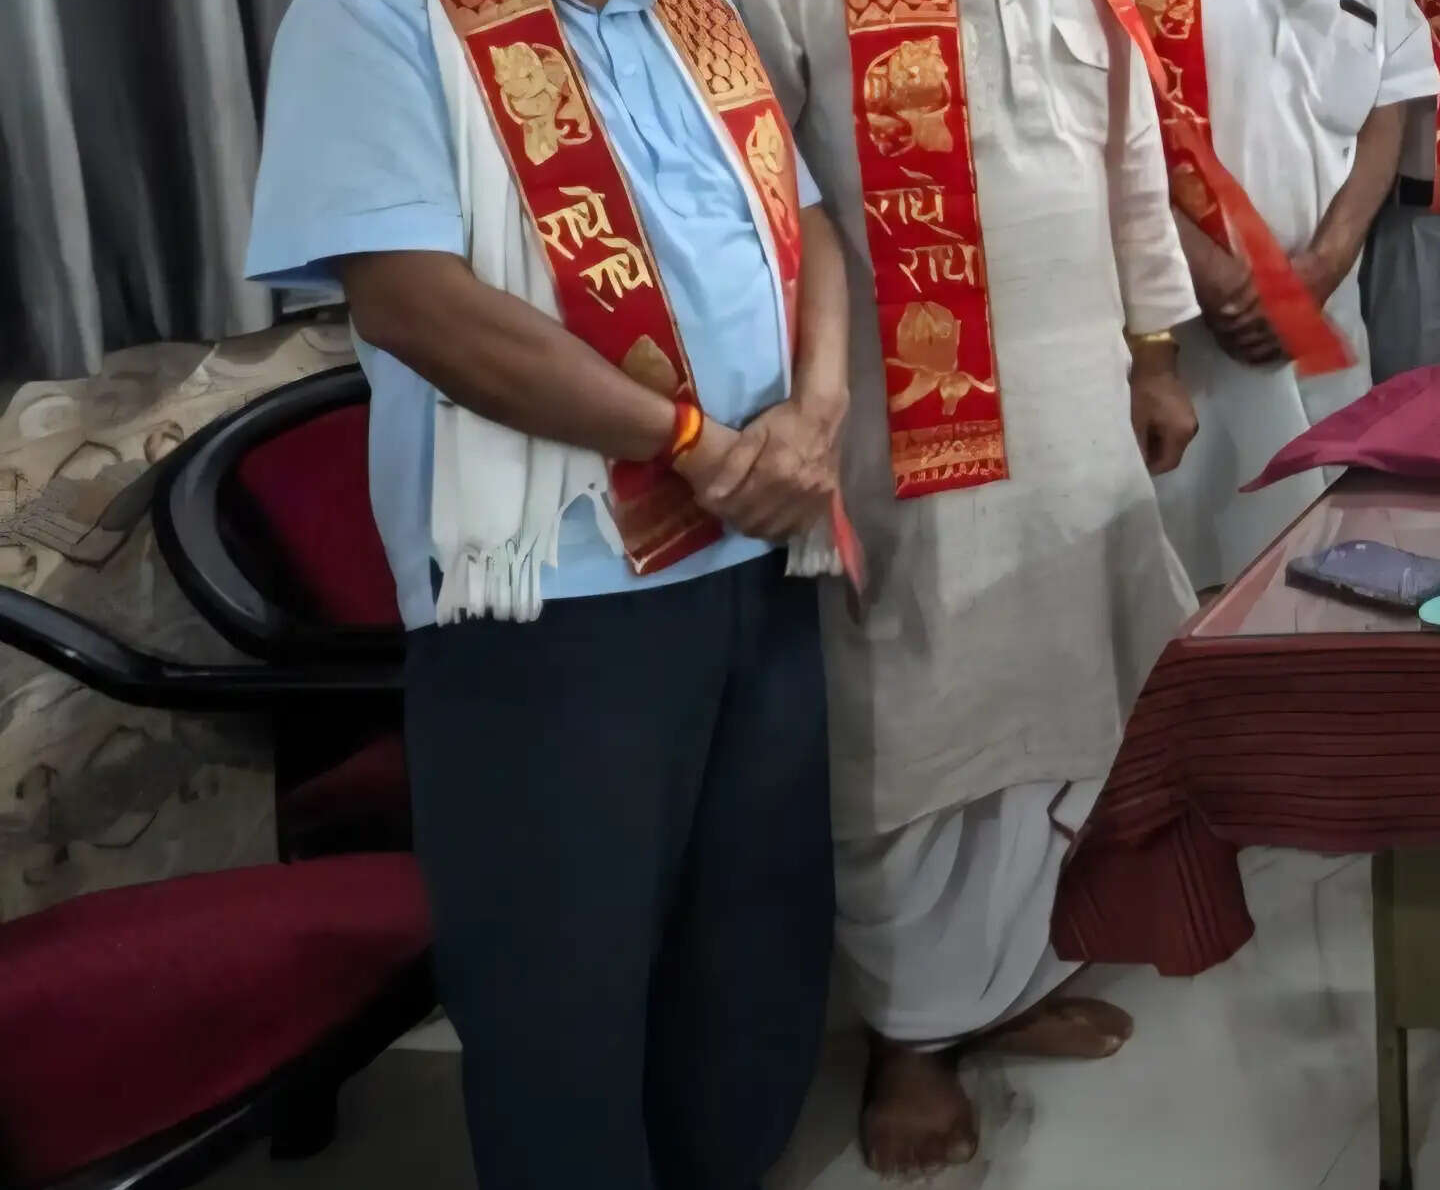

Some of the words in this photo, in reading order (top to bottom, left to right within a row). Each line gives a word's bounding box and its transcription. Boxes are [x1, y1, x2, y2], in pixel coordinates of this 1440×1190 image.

[537, 185, 614, 260] राधे
[863, 166, 945, 236] राधे
[578, 236, 654, 313] राधे
[898, 221, 979, 293] राधे
